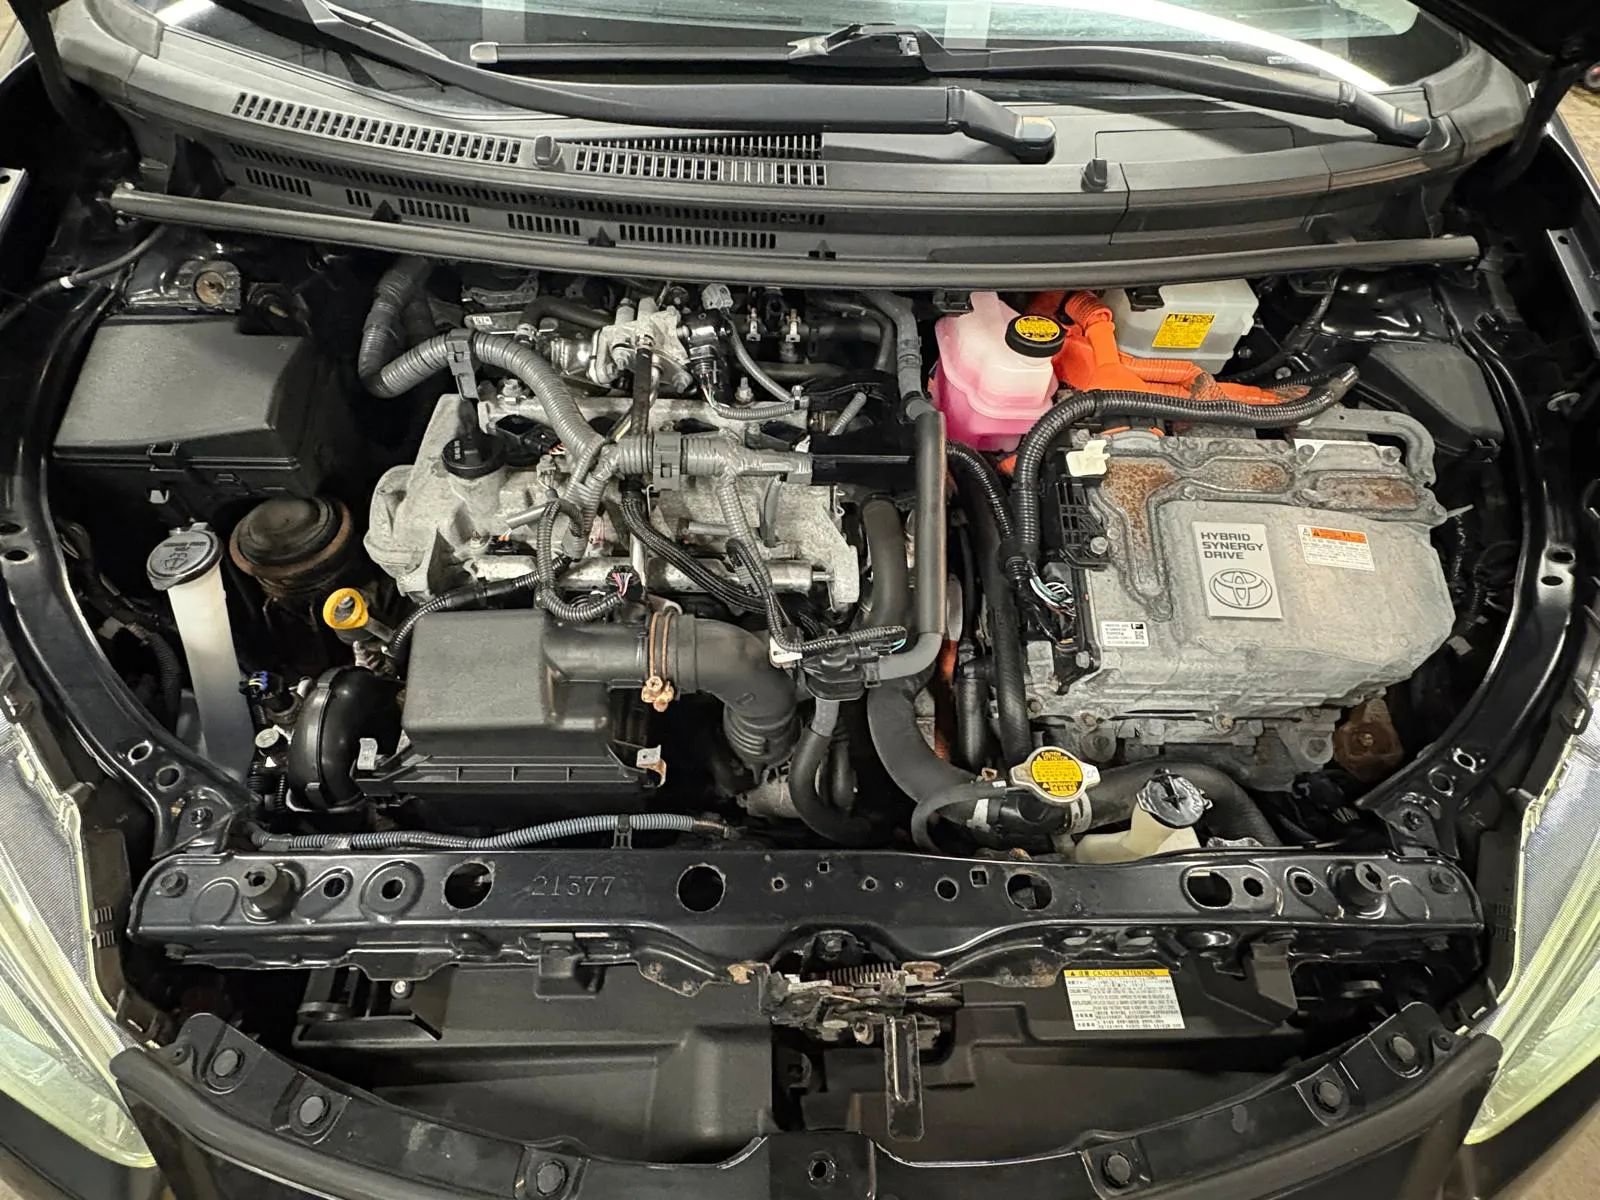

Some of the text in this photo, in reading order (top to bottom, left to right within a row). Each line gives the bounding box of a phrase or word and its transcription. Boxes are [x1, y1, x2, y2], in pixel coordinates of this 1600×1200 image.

[1200, 532, 1251, 541] HYBRID
[1202, 541, 1264, 551] SYNERGY
[1204, 551, 1245, 559] DRIVE
